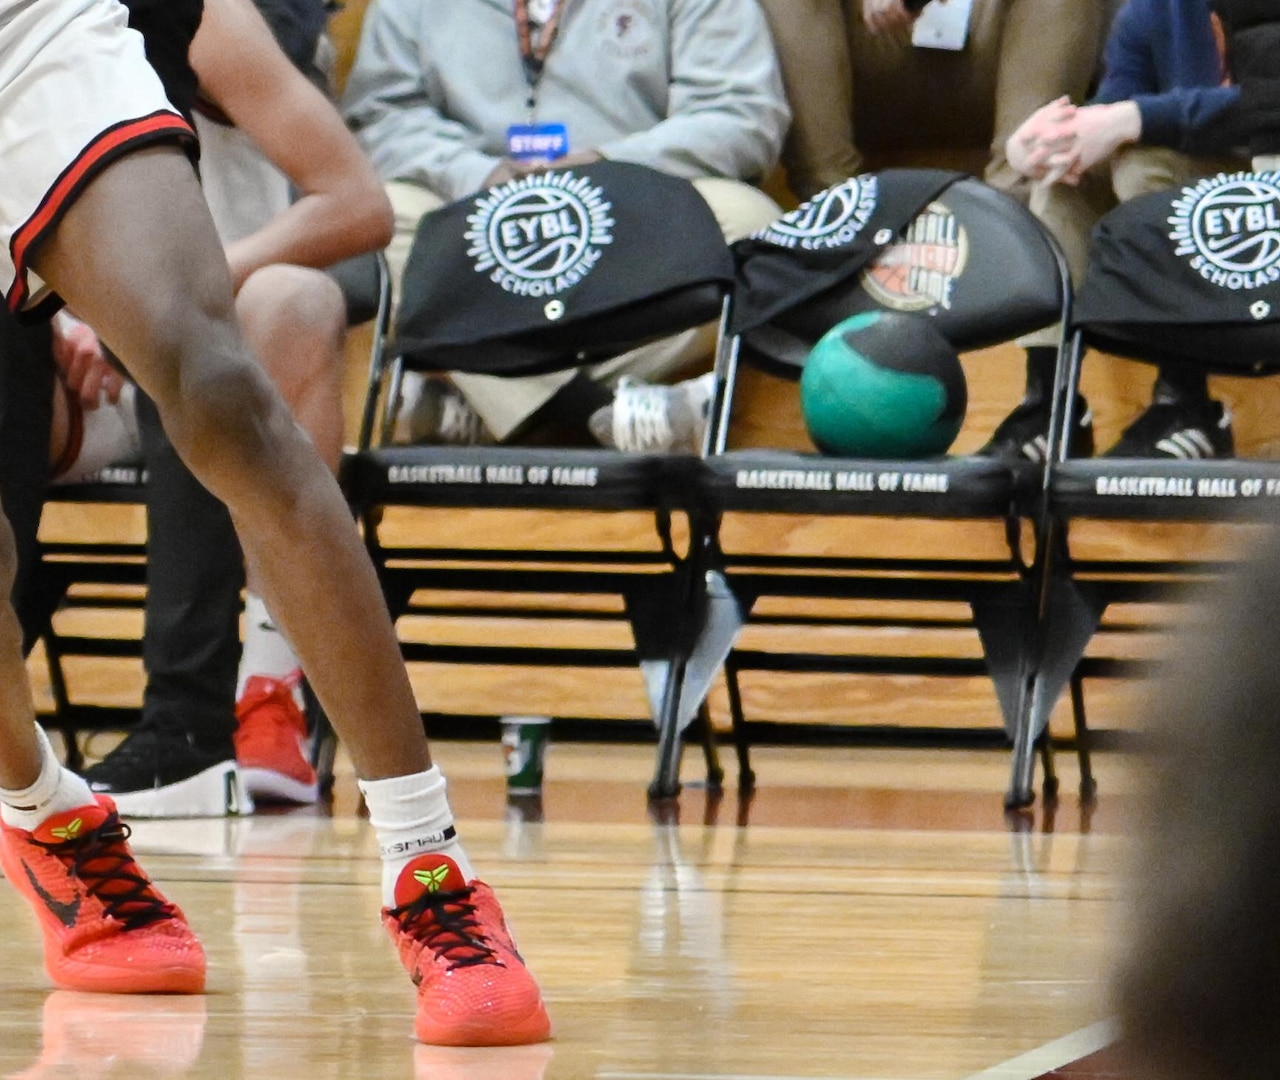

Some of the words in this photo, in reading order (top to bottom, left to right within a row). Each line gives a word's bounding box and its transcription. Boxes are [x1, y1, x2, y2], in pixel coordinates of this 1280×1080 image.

[509, 134, 563, 153] STAFF
[500, 209, 578, 247] EYBL
[1205, 202, 1280, 236] EYBL
[490, 246, 603, 298] SCHOLASTIC
[387, 464, 482, 484] BASKETBALL
[486, 465, 524, 484] HALL
[527, 466, 550, 485] OF
[552, 467, 599, 487] FAME
[736, 469, 832, 491] BASKETBALL
[836, 471, 874, 491] HALL
[878, 472, 900, 492] OF
[903, 472, 950, 493] FAME
[1096, 476, 1193, 497] BASKETBALL
[1197, 478, 1237, 497] HALL
[1241, 478, 1263, 497] OF
